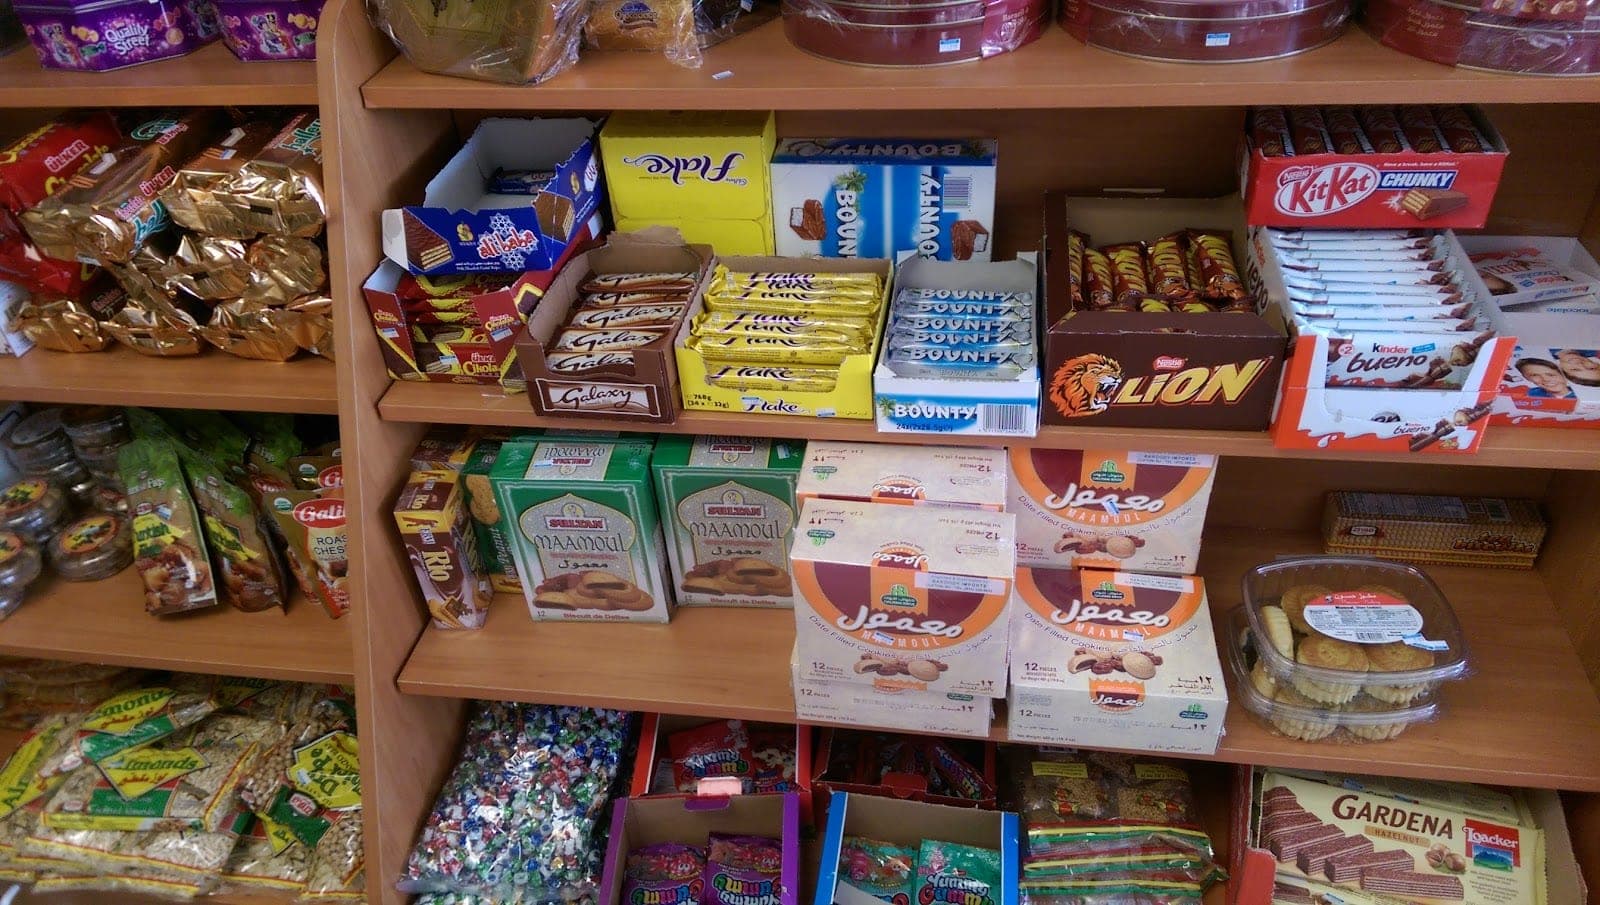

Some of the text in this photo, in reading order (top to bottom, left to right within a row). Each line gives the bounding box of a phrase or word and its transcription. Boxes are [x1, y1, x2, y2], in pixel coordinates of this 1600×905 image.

[105, 23, 149, 43] Quality
[114, 35, 150, 55] Street
[46, 140, 88, 172] ÜLKER
[830, 143, 962, 157] BOUNTY
[624, 153, 744, 185] Flake
[1289, 167, 1370, 213] KitKat
[1381, 172, 1454, 188] CHUNKY
[834, 189, 859, 257] BOUN
[584, 304, 683, 328] Galaxy
[570, 331, 660, 352] Galax
[1372, 342, 1409, 355] kinder
[552, 353, 635, 371] Galax
[911, 348, 1012, 364] BOUNTY
[1346, 352, 1428, 374] bueno
[1114, 360, 1266, 405] LION
[560, 386, 632, 409] Galaxy
[894, 404, 978, 420] BOUNTY
[1393, 424, 1431, 436] bueno
[1045, 482, 1167, 514] معمول
[707, 506, 762, 516] SULTAN
[549, 518, 604, 530] SULTAN
[689, 520, 785, 539] MAAMOUL
[534, 533, 631, 553] MAAMOUL
[985, 532, 1001, 541] 12
[314, 546, 347, 556] CHES
[421, 550, 454, 583] Rio
[836, 604, 965, 638] معمول
[1050, 599, 1172, 629] معمول
[809, 614, 830, 634] Date
[830, 631, 855, 648] Filled
[861, 630, 942, 648] MMOUL
[1024, 611, 1112, 653] Date Filled Cookies
[1074, 622, 1152, 641] MAAML
[811, 661, 826, 670] 12
[1023, 662, 1039, 672] 12
[799, 687, 814, 697] 12
[1018, 709, 1034, 718] 12
[685, 749, 741, 770] Yummy
[1331, 794, 1455, 840] GARDENA
[1374, 827, 1422, 845] HAZELNUT
[1461, 825, 1520, 848] Loacker
[927, 871, 991, 896] Yummy
